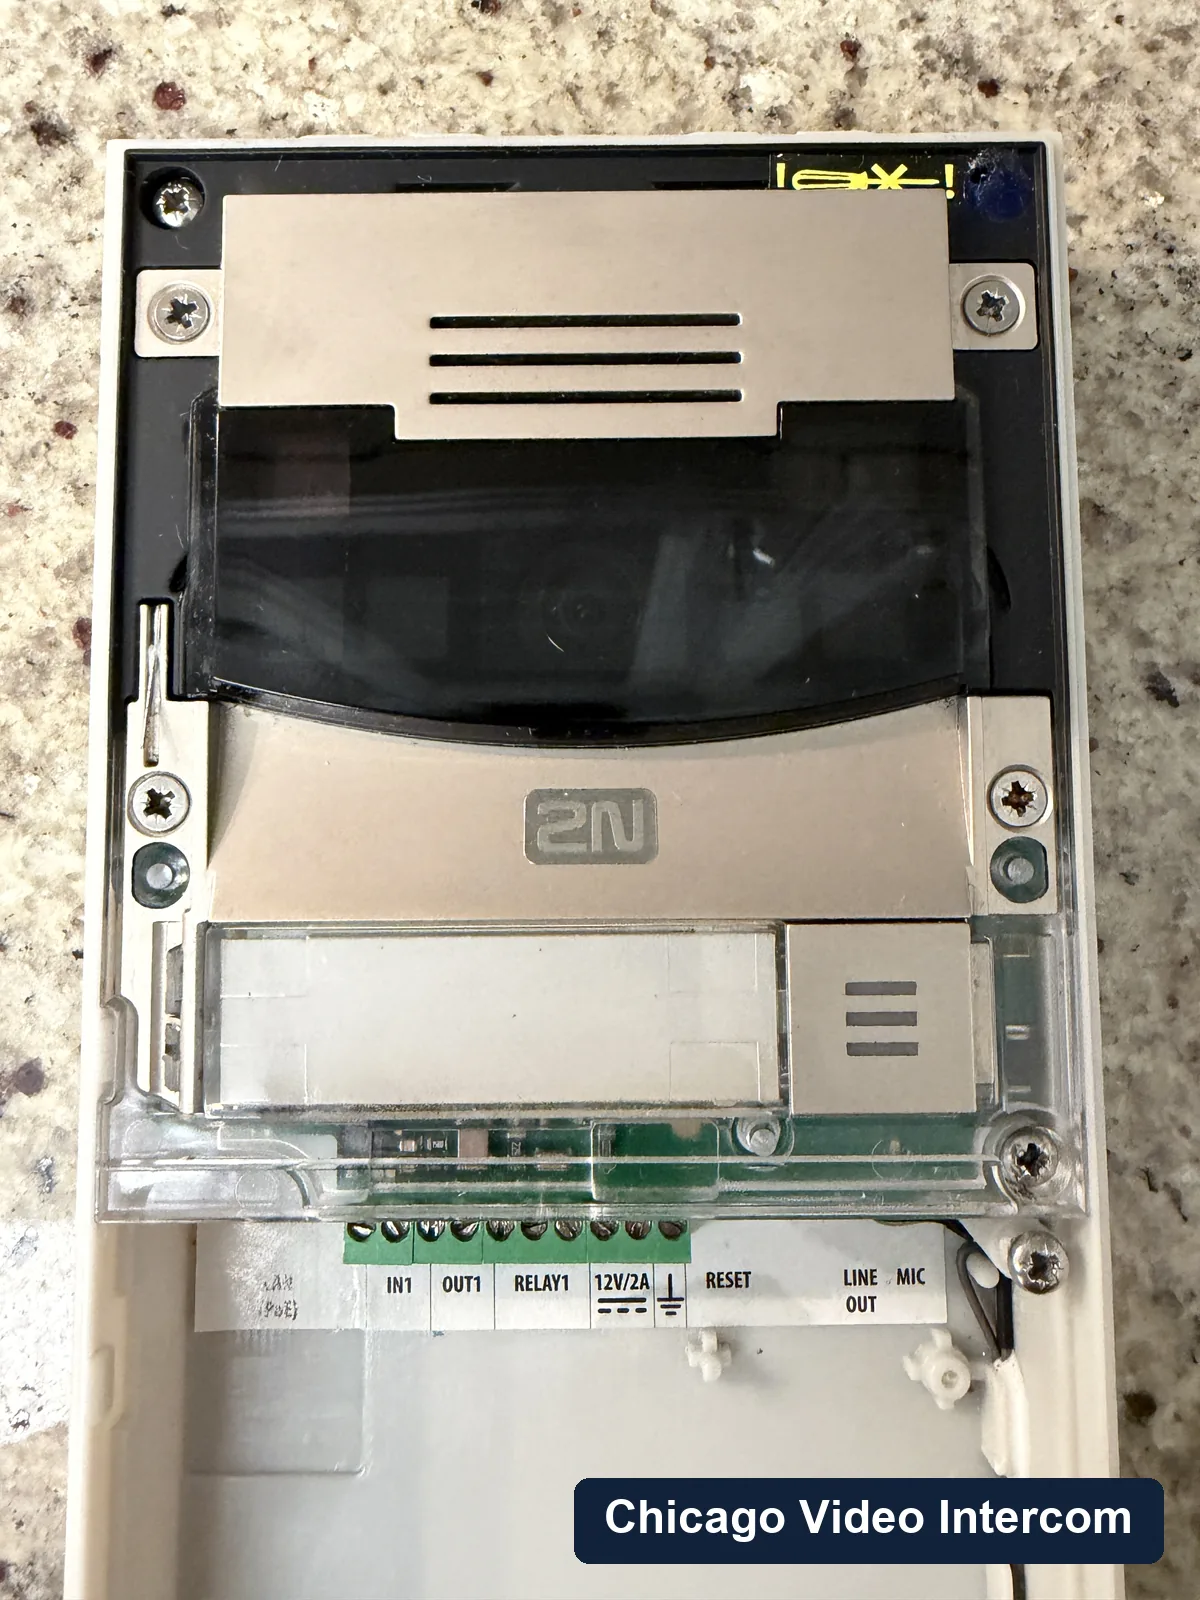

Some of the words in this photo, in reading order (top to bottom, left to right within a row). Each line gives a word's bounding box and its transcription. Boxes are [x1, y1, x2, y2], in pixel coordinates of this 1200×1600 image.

[537, 799, 644, 852] 2N
[387, 1276, 412, 1294] IN1
[442, 1275, 481, 1293] OUT1
[514, 1273, 569, 1292] RELAY1
[594, 1272, 651, 1291] 12V/2A
[705, 1270, 752, 1290] RESET
[843, 1268, 878, 1287] LINE
[896, 1267, 926, 1286] MIC
[846, 1295, 877, 1313] OUT
